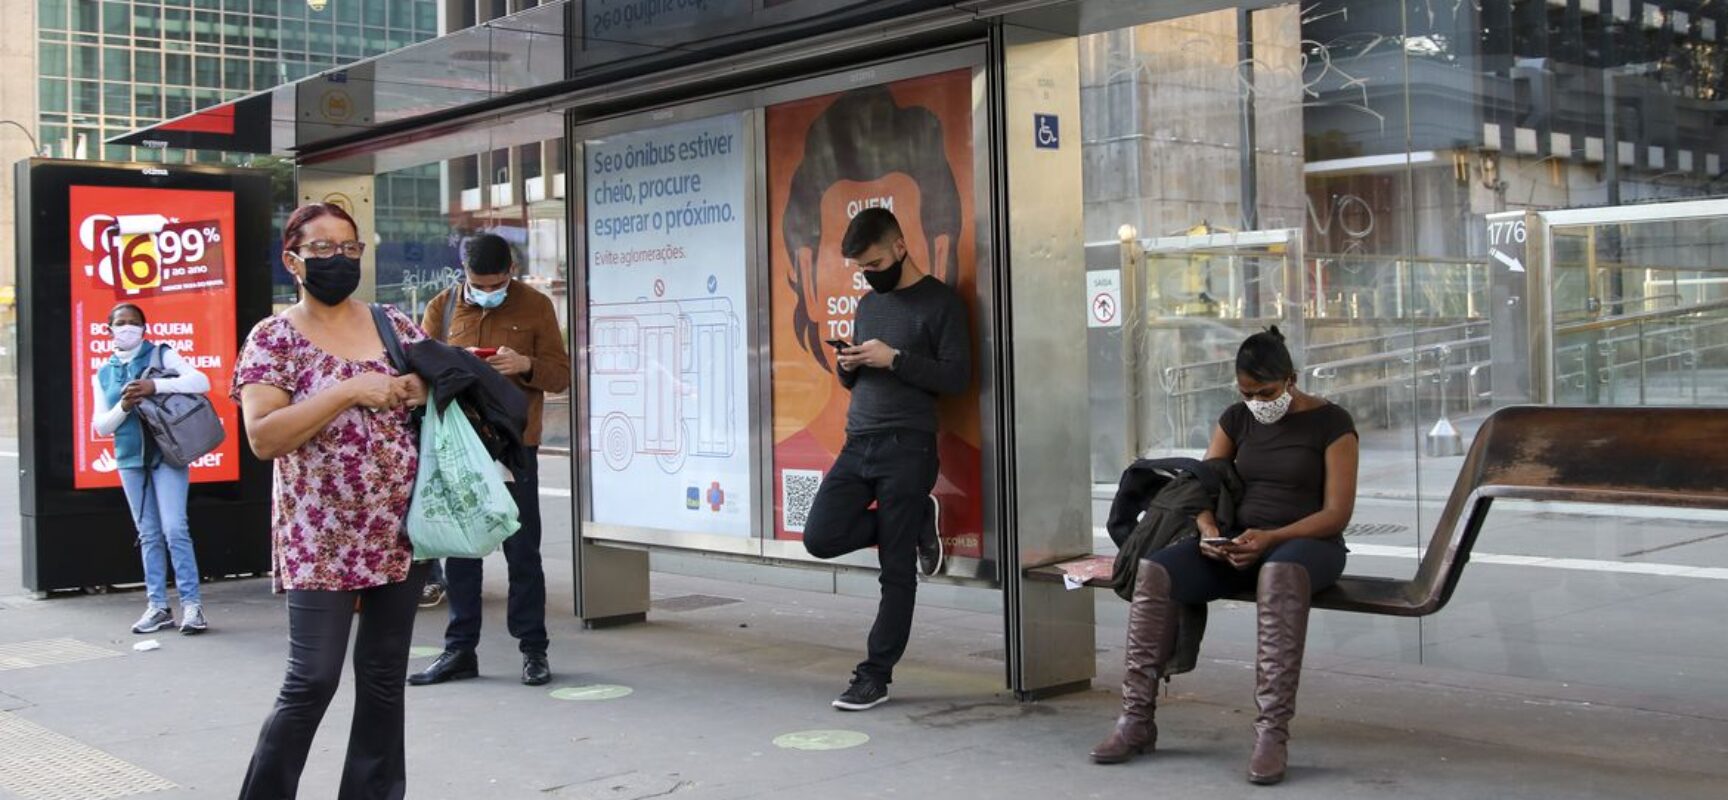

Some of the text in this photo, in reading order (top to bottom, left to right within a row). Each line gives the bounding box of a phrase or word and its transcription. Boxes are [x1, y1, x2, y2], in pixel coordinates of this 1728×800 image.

[594, 132, 734, 174] Se o ônibus estiver
[595, 174, 701, 205] cheio, procure
[595, 200, 735, 240] esperar o próximo.
[1487, 220, 1526, 245] 1776
[595, 244, 686, 267] Evite aglomerações.
[153, 323, 193, 335] QUEM
[90, 340, 116, 353] QUE
